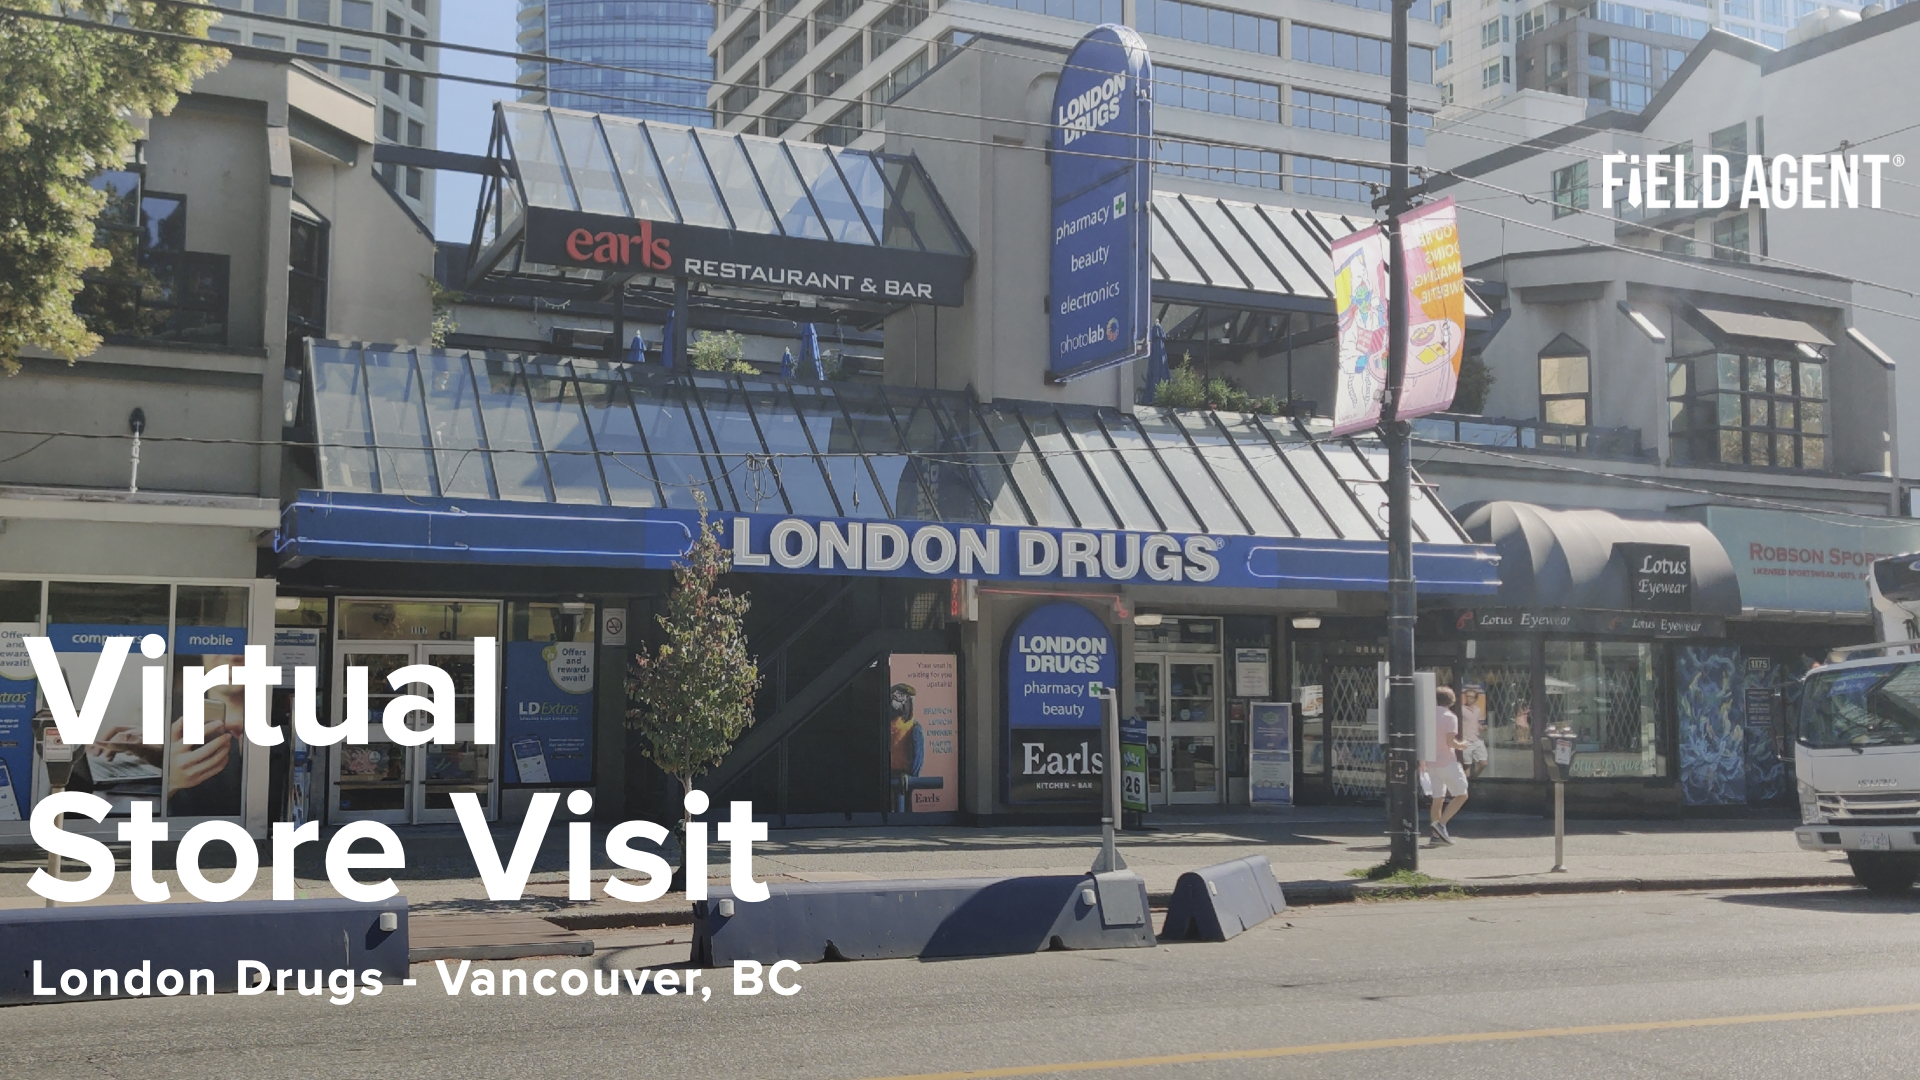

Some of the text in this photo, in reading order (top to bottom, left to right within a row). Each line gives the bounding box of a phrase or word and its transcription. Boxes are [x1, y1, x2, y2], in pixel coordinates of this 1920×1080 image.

[1059, 70, 1126, 126] LONDON
[1056, 203, 1110, 245] pharmacy
[566, 221, 933, 300] earls RESTAURANT & BAR
[1071, 244, 1110, 272] beauty
[1060, 280, 1120, 316] electronics
[1060, 325, 1105, 357] photolab
[732, 517, 1001, 575] LONDON
[1750, 543, 1892, 567] ROBSON SPOR
[1639, 555, 1687, 575] Lotus
[1638, 579, 1688, 600] Eyewear
[1480, 613, 1571, 628] Lotus Eyewear
[1632, 618, 1702, 633] Lotus Eyewear
[72, 634, 143, 646] comprs
[189, 634, 233, 646] mobile
[1019, 636, 1107, 655] LONDON
[562, 648, 587, 656] Offers
[557, 665, 590, 673] rewards
[1026, 655, 1100, 673] DRUGS
[1751, 660, 1768, 668] 1175
[561, 674, 586, 682] await!
[1024, 681, 1084, 698] pharmacy
[1042, 702, 1084, 718] beauty
[928, 718, 952, 726] LUNCH
[932, 746, 953, 754] HOUR
[1022, 742, 1103, 776] Earls
[1036, 782, 1069, 790] KITCHEN
[1125, 775, 1141, 793] 26
[1857, 778, 1898, 788] ISUZU
[915, 793, 940, 803] Earls
